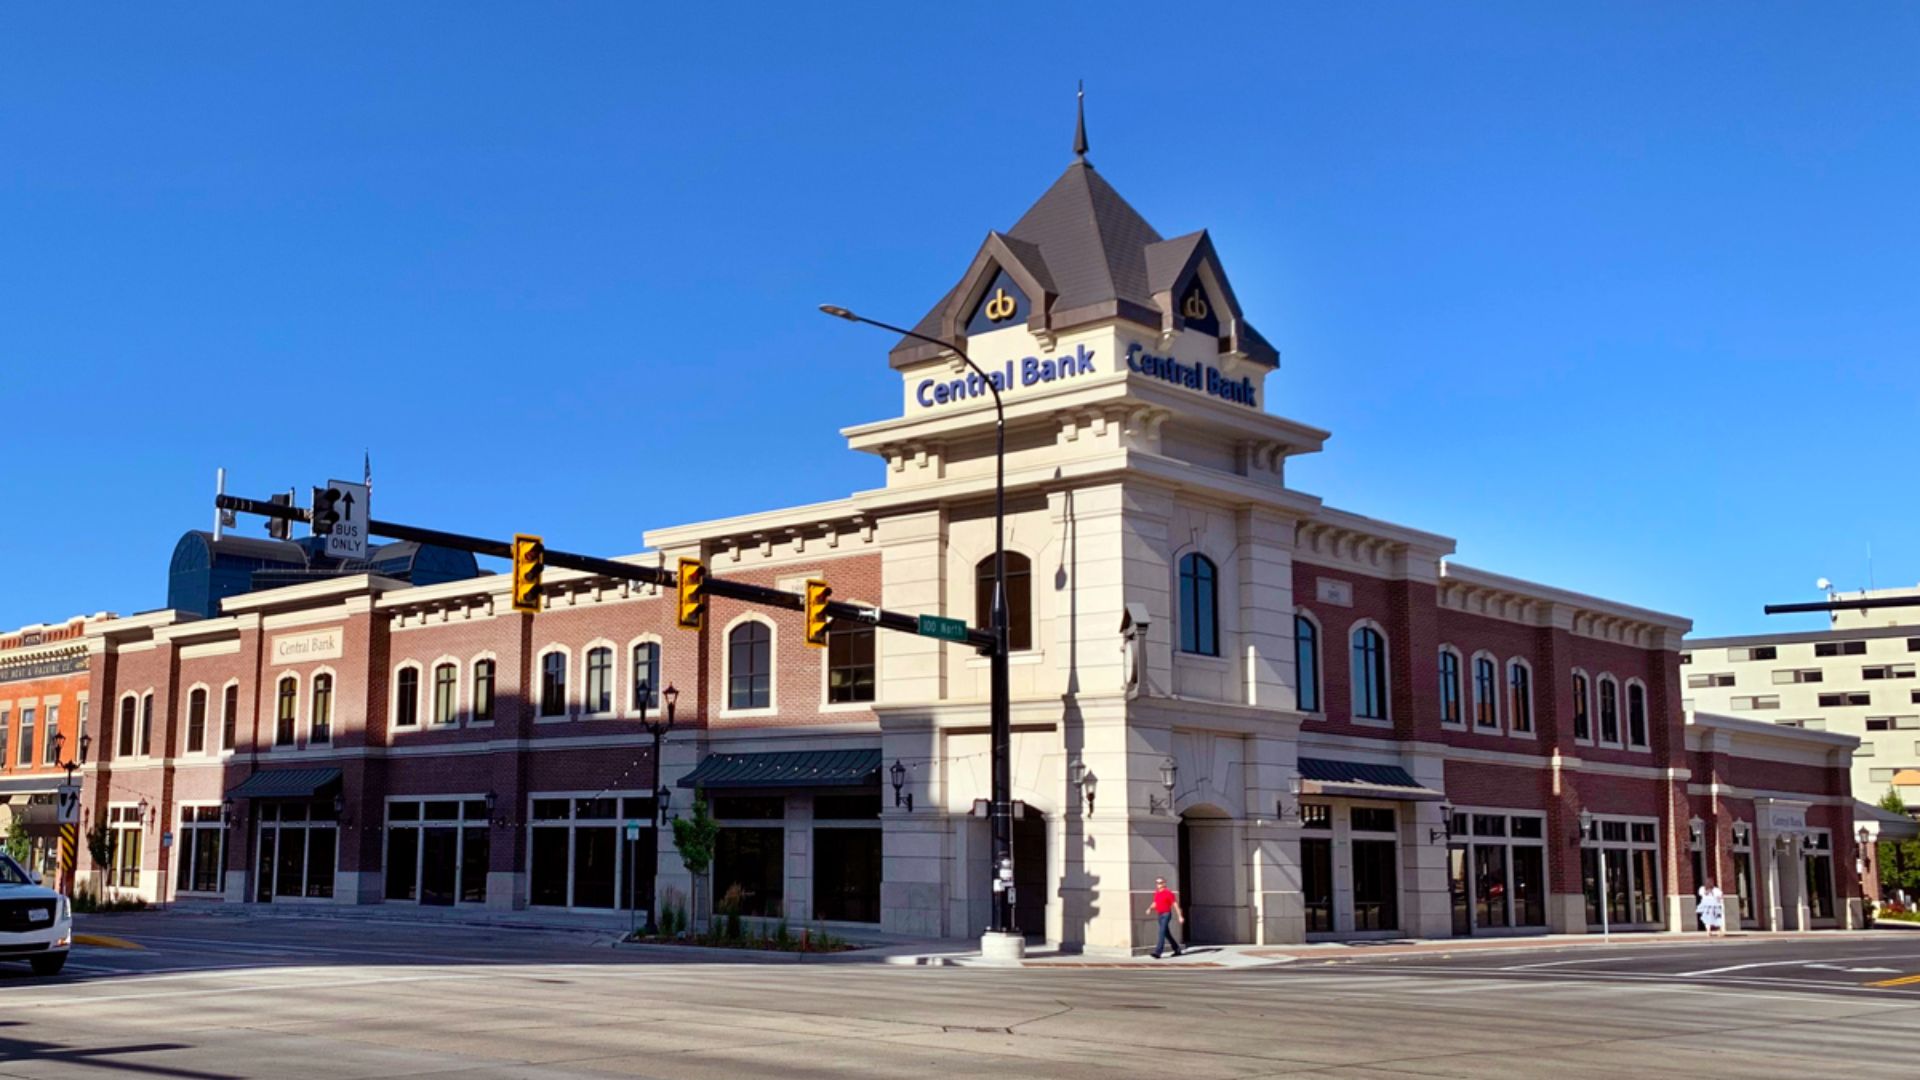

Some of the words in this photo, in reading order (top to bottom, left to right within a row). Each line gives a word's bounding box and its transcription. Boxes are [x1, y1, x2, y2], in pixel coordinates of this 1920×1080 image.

[916, 360, 1014, 407] Central
[1021, 344, 1097, 386] Bank
[1126, 343, 1204, 391] Central
[1206, 366, 1257, 407] Bank
[336, 523, 358, 537] BUS
[332, 537, 362, 551] ONLY
[923, 619, 937, 633] 100
[941, 622, 964, 636] North
[279, 638, 310, 656] Central
[311, 634, 335, 652] Bank
